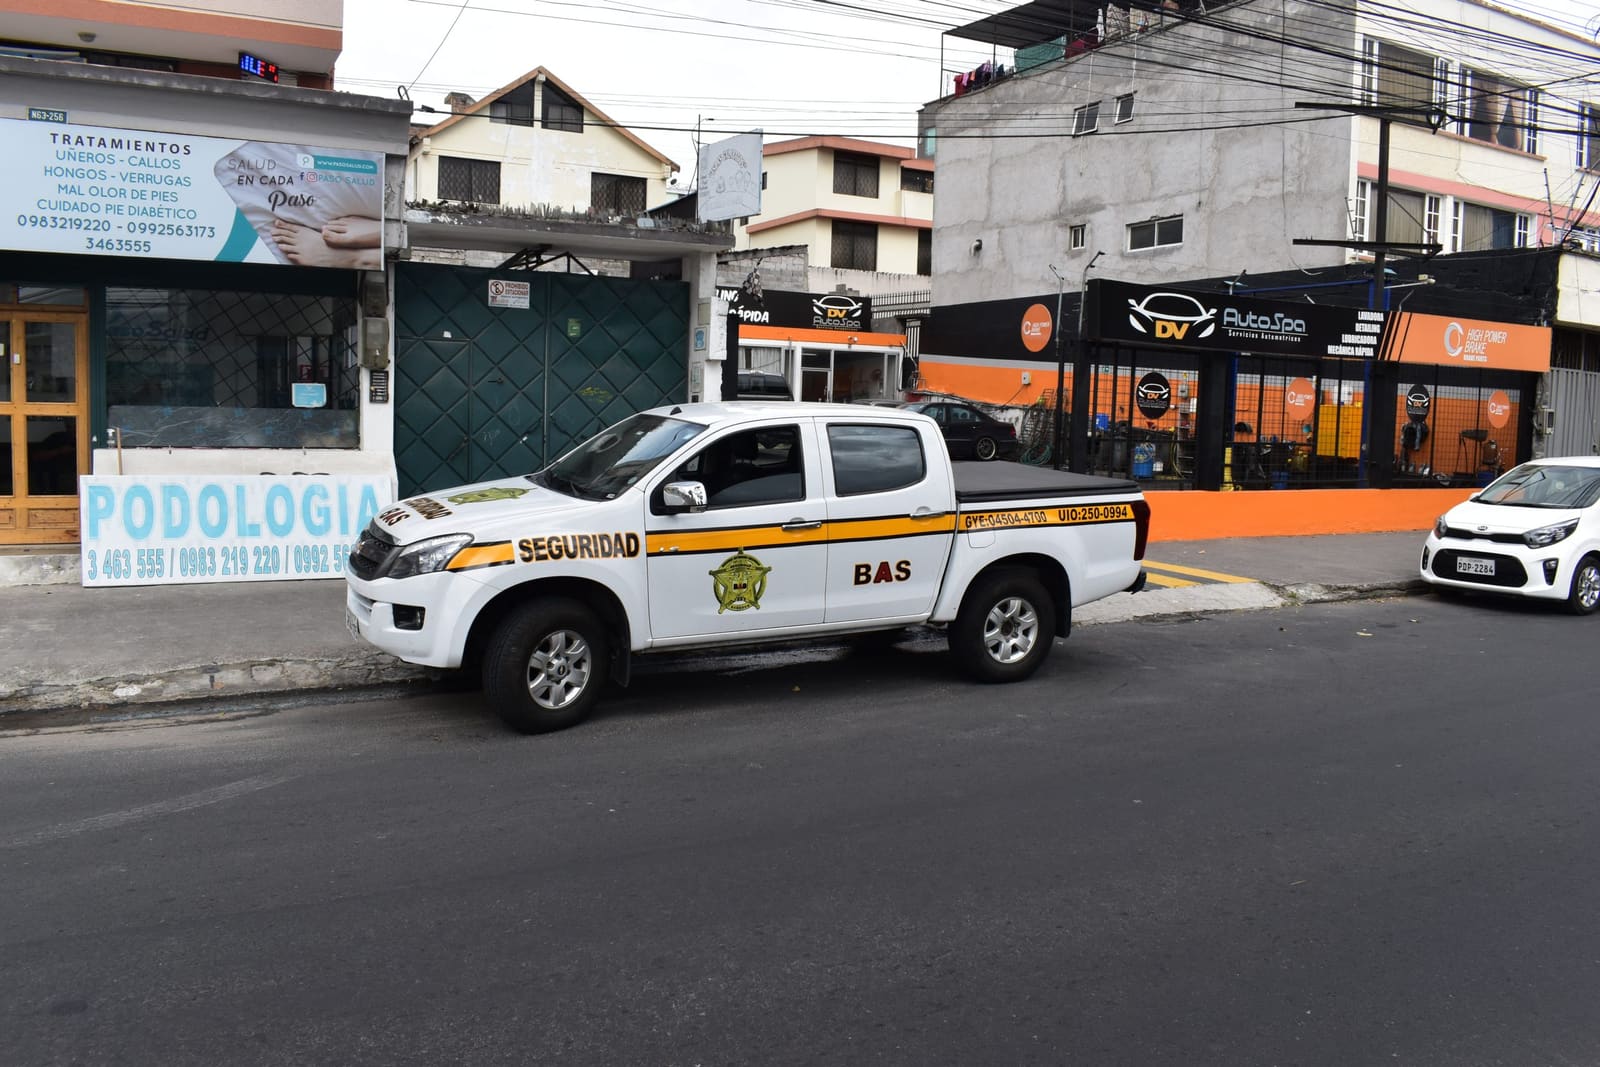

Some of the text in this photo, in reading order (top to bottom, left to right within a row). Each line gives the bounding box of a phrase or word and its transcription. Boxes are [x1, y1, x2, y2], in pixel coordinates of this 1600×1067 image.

[31, 110, 64, 122] N63-256
[50, 133, 191, 155] TRATAMIENTOS
[56, 147, 115, 165] UÑEROS
[128, 156, 181, 170] CALLOS
[228, 158, 277, 170] SALUD
[44, 166, 107, 181] HONGOS
[119, 171, 192, 187] VERRUGAS
[237, 175, 294, 185] EN CADA
[318, 174, 375, 186] PASO SALUD
[57, 183, 178, 202] MAL OLOR DE PIES
[268, 190, 316, 212] Paso
[37, 199, 197, 220] CUIDADO PIE DIABÉTICO
[17, 214, 111, 232] 0983219220
[127, 221, 216, 239] 0992563173
[85, 237, 152, 253] 3463555
[827, 308, 847, 318] DV
[1223, 307, 1306, 335] AutoSpa
[1155, 320, 1190, 340] DV
[1467, 328, 1507, 344] HIGH POWER
[1465, 341, 1487, 354] BRAKE
[87, 484, 380, 539] PODOLOGIA
[965, 506, 1128, 529] GYE:04504-4700 UIO:250-0994
[518, 531, 640, 563] SEGURIDAD
[88, 549, 97, 580] 3
[102, 549, 131, 579] 463
[137, 548, 164, 578] 555
[179, 547, 216, 577] 0983
[221, 546, 248, 575] 219
[253, 545, 280, 574] 220
[294, 544, 329, 573] 0992
[853, 560, 911, 586] BAS
